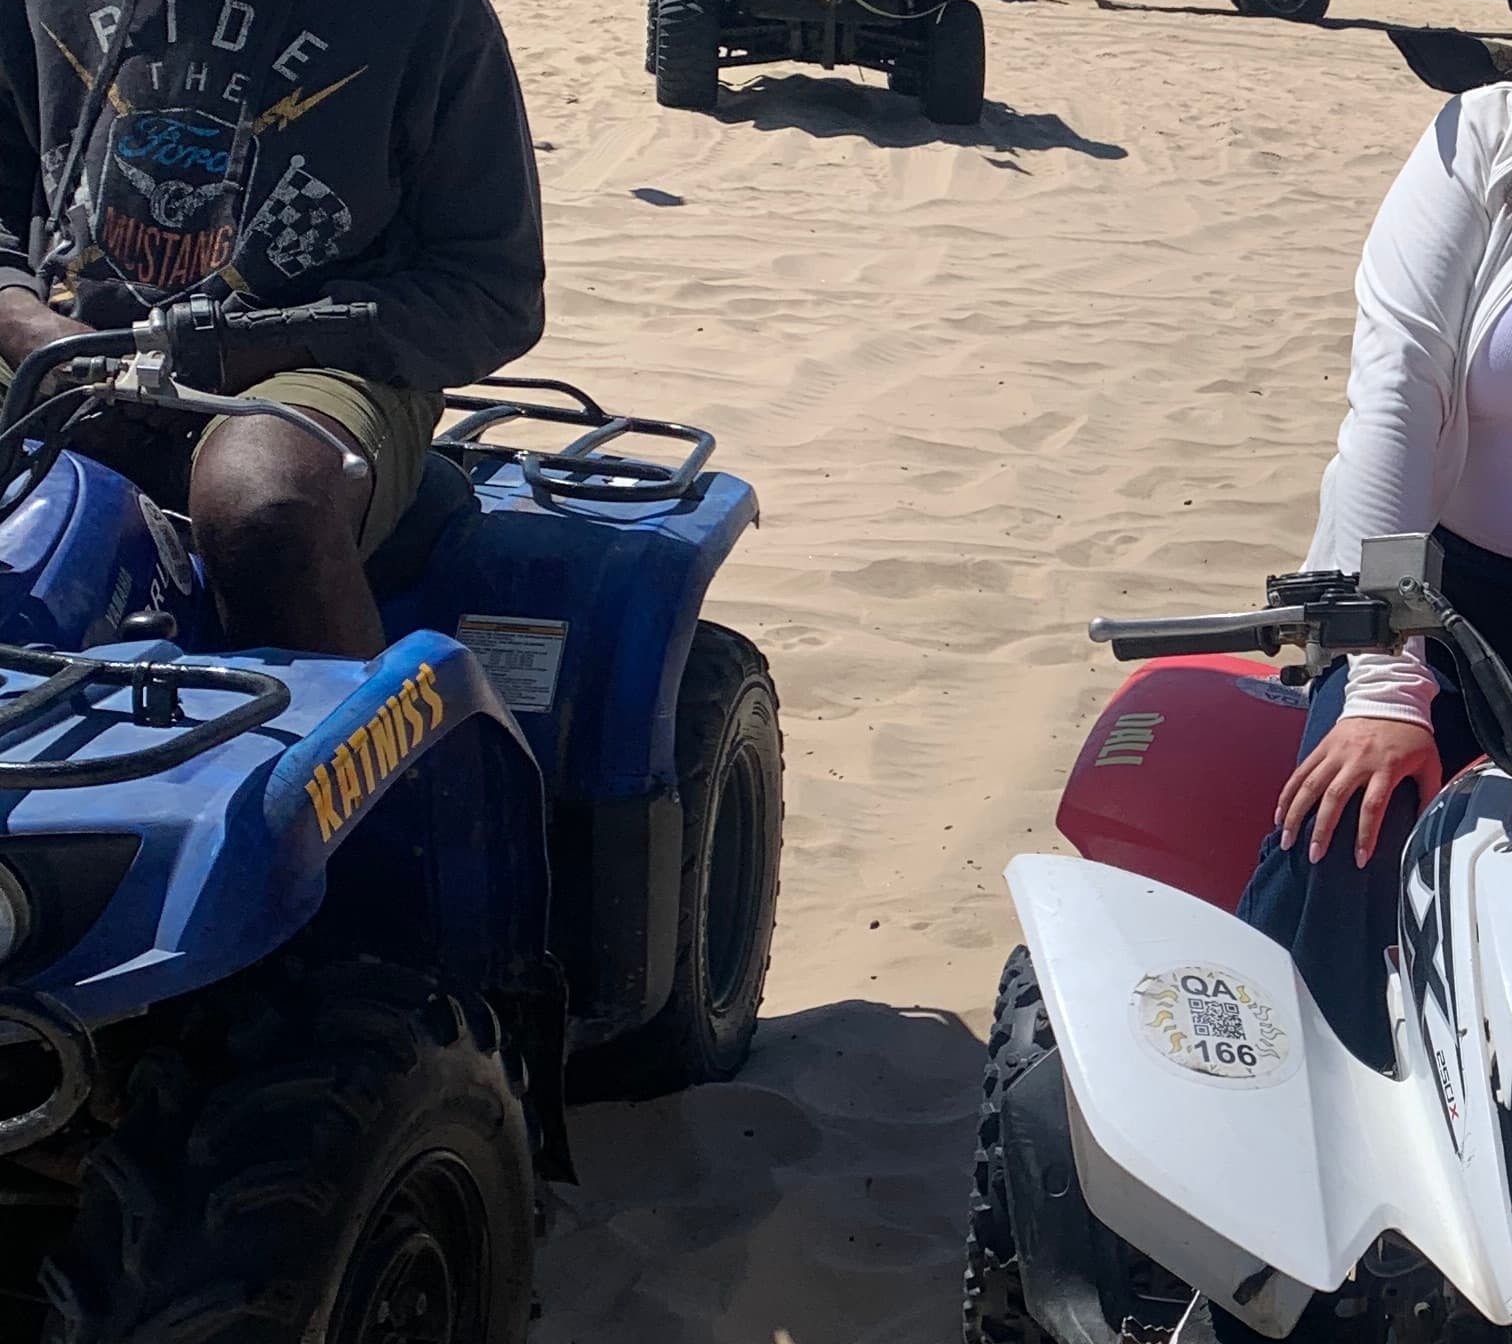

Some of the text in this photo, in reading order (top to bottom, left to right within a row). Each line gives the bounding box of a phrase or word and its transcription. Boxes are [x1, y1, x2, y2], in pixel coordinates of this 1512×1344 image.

[147, 61, 251, 104] THE
[103, 205, 234, 288] MUSTANG
[304, 661, 444, 844] KATNISS
[1180, 974, 1238, 1001] QA
[1193, 1039, 1258, 1067] 166
